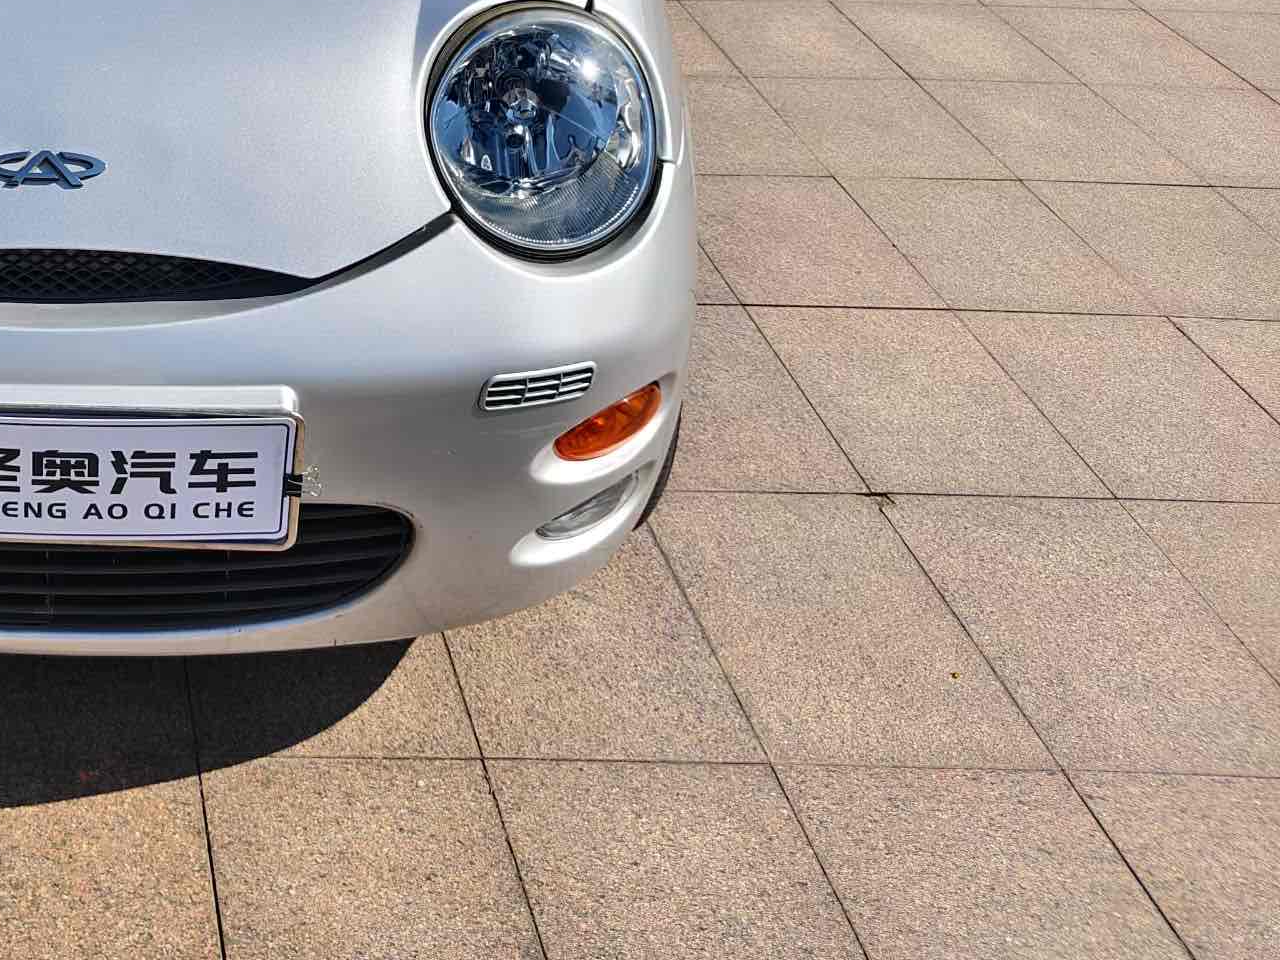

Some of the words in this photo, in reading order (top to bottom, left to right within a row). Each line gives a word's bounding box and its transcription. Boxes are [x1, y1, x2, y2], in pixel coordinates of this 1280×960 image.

[83, 502, 129, 520] AO
[144, 502, 176, 520] QI
[193, 501, 255, 519] CHE
